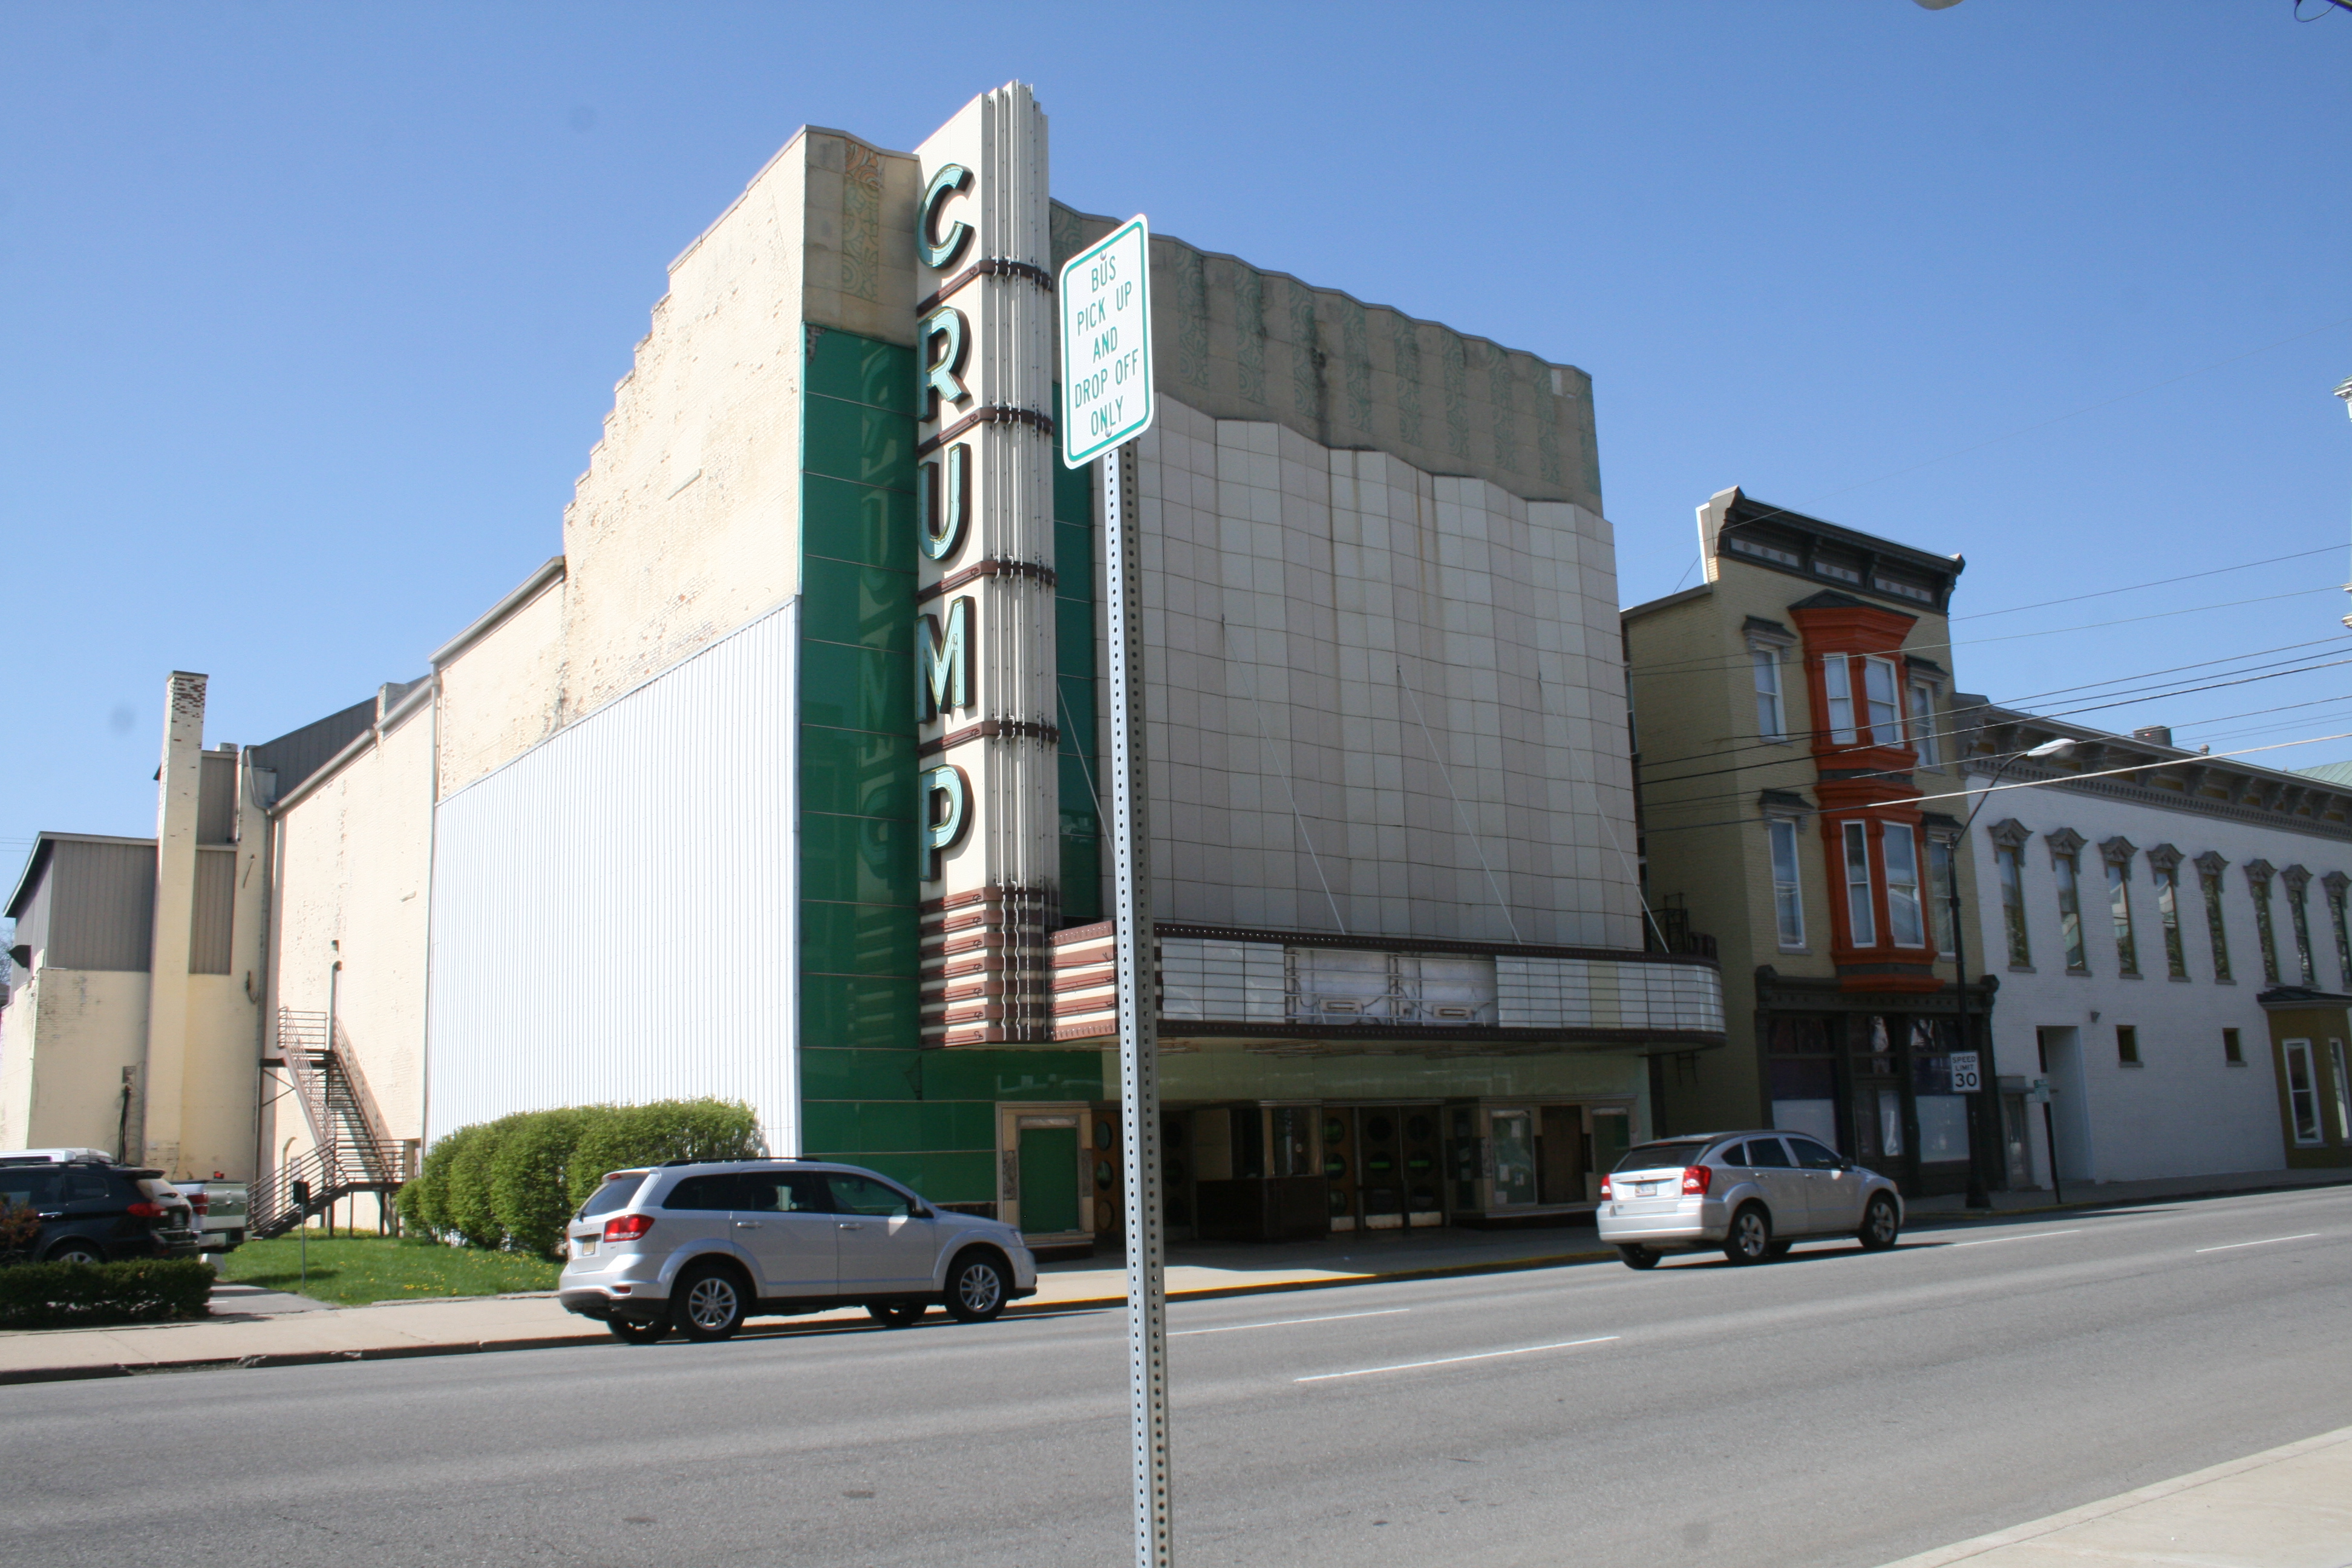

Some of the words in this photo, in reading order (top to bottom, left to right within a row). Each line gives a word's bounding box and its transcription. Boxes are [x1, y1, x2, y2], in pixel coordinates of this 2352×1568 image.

[1091, 255, 1116, 293] BUS
[1077, 296, 1106, 336] PICK
[1116, 281, 1132, 312] UP
[1093, 327, 1118, 364] AND
[1075, 368, 1108, 409] DROP
[1116, 348, 1138, 385] OFF
[1091, 396, 1123, 436] ONLY
[915, 163, 975, 882] CRUMP
[1955, 1073, 1977, 1087] 30
